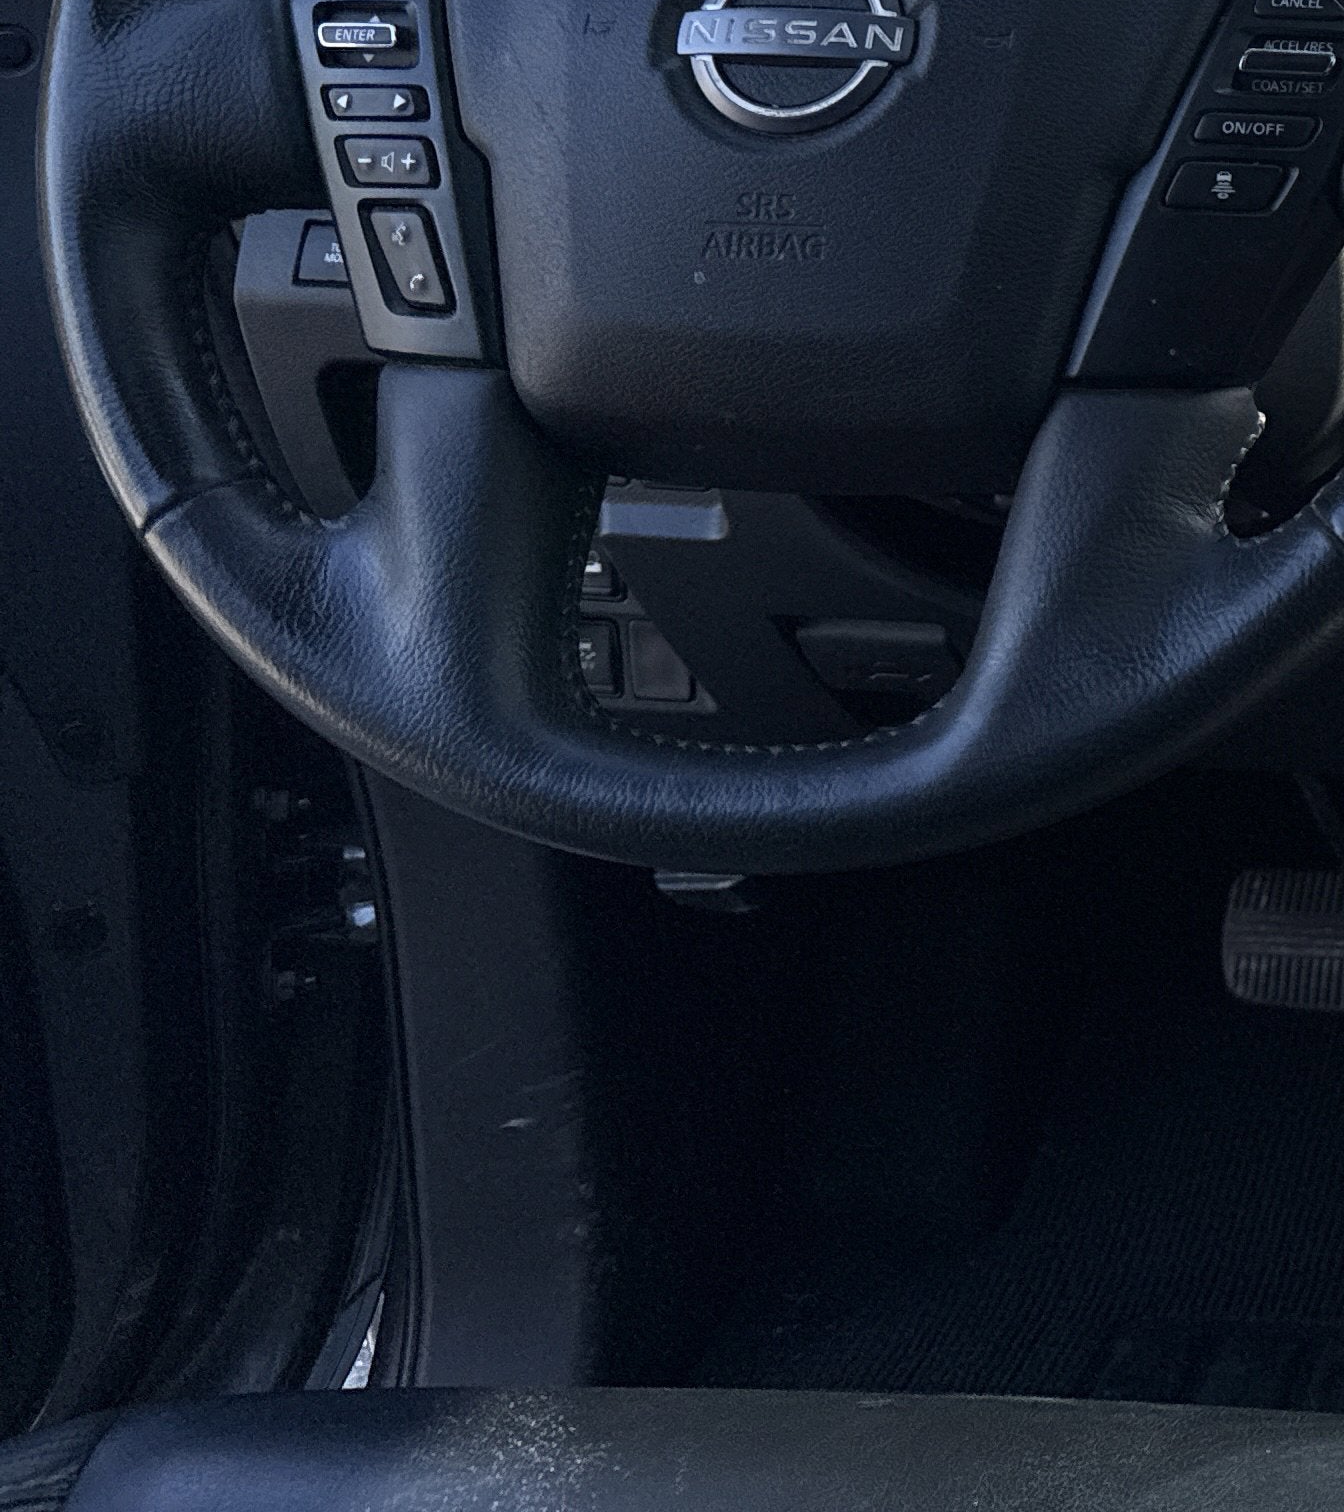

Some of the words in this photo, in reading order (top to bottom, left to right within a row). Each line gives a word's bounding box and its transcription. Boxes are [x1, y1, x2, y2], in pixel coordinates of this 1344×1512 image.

[335, 27, 376, 42] ENTER
[685, 18, 905, 52] NISSAN
[1263, 39, 1334, 52] ACCEL/RES
[1251, 80, 1324, 94] COAST/SET
[1221, 121, 1285, 136] ON/OFF
[735, 192, 795, 221] SRS
[703, 230, 826, 260] AIRBAG
